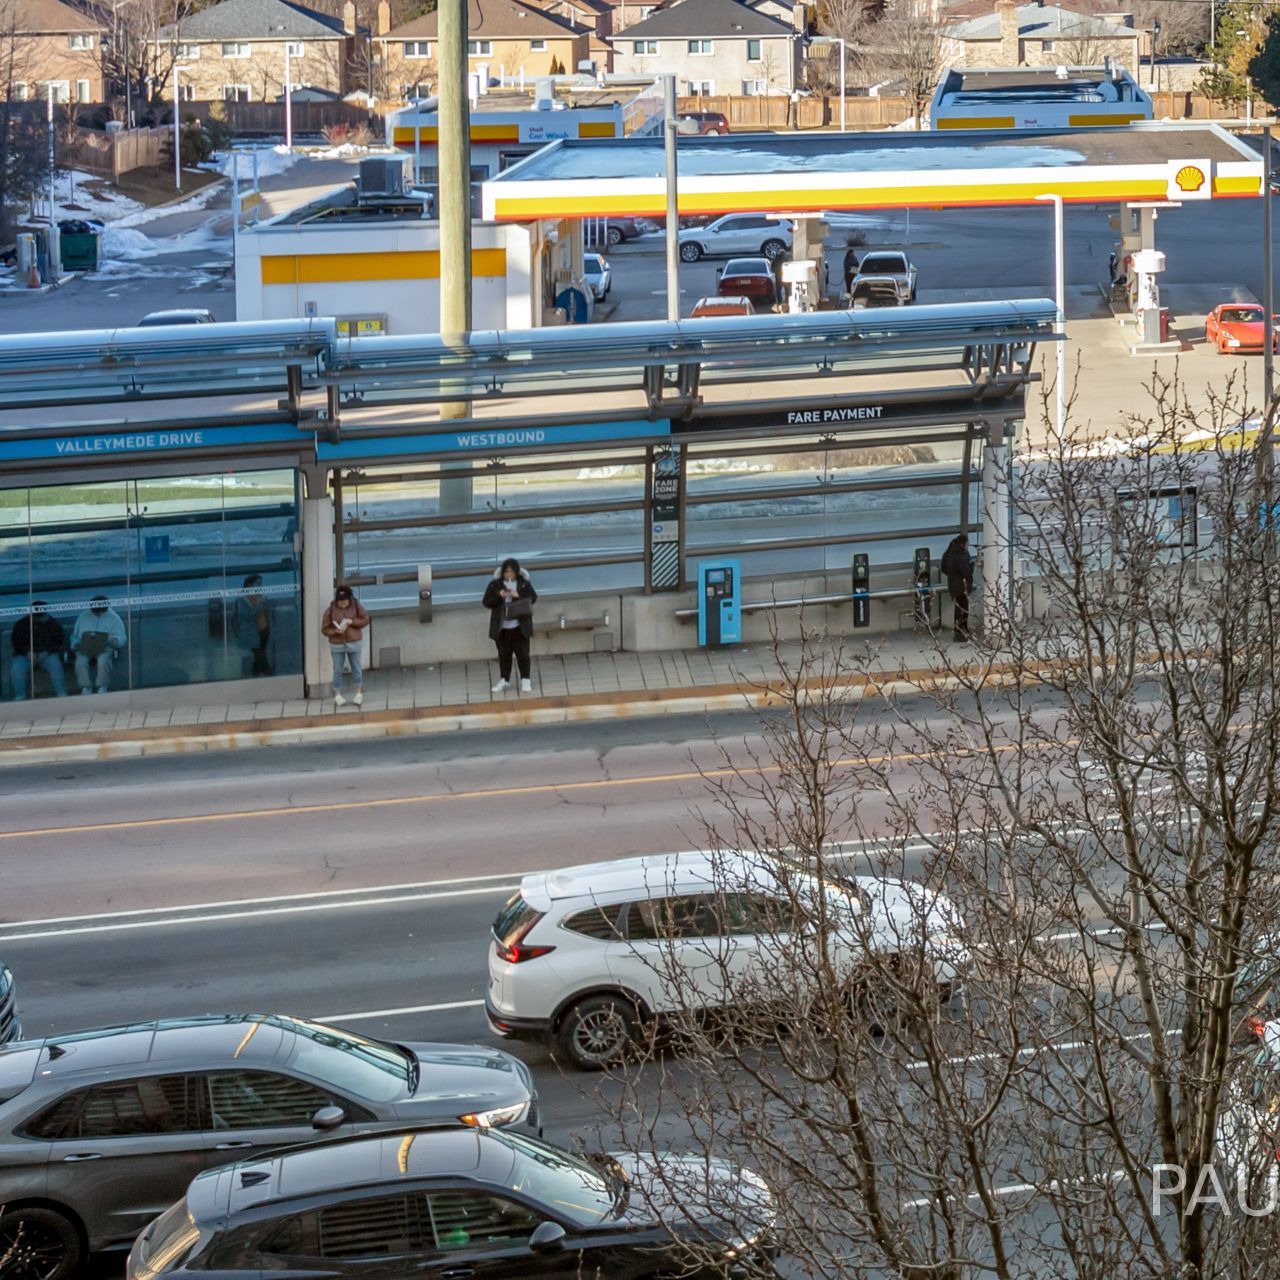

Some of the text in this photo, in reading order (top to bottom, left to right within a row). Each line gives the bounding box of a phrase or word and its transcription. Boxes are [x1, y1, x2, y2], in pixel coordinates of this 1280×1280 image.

[787, 406, 883, 424] FARE PAYMENT
[56, 431, 203, 453] VALLEYMEDE DRIVE
[457, 430, 545, 447] WESTBOUND
[655, 486, 678, 494] ZONE
